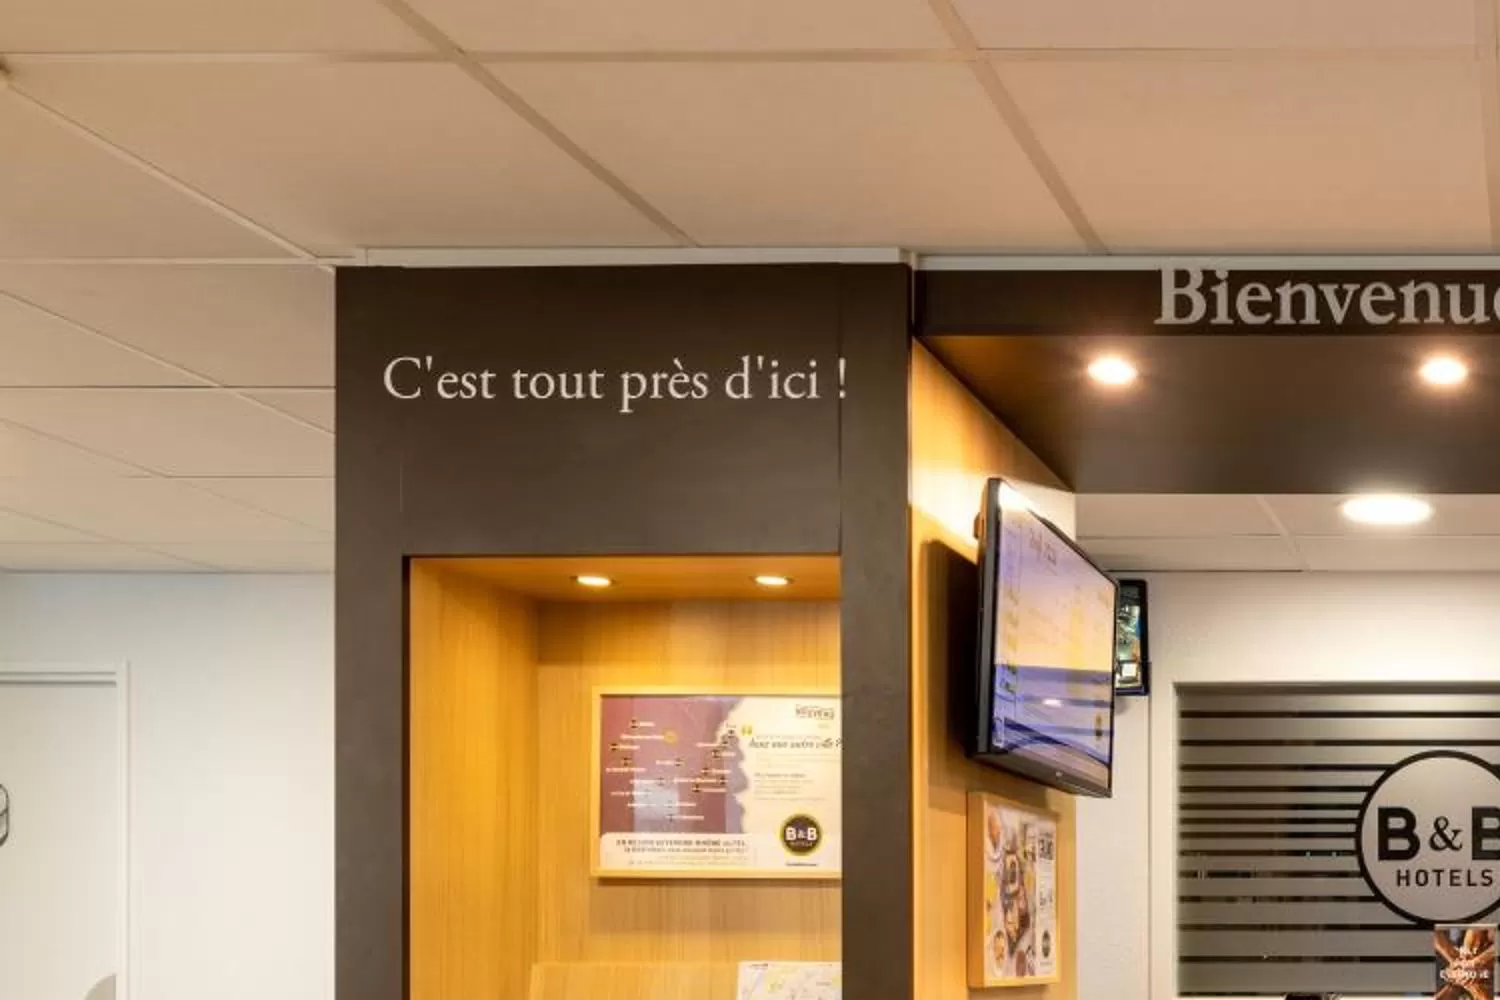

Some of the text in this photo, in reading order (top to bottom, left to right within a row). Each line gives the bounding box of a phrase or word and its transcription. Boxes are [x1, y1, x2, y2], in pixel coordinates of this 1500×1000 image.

[383, 355, 848, 413] C'est tout près d'ici !
[785, 826, 817, 841] B&B
[1396, 869, 1494, 887] HOTELS
